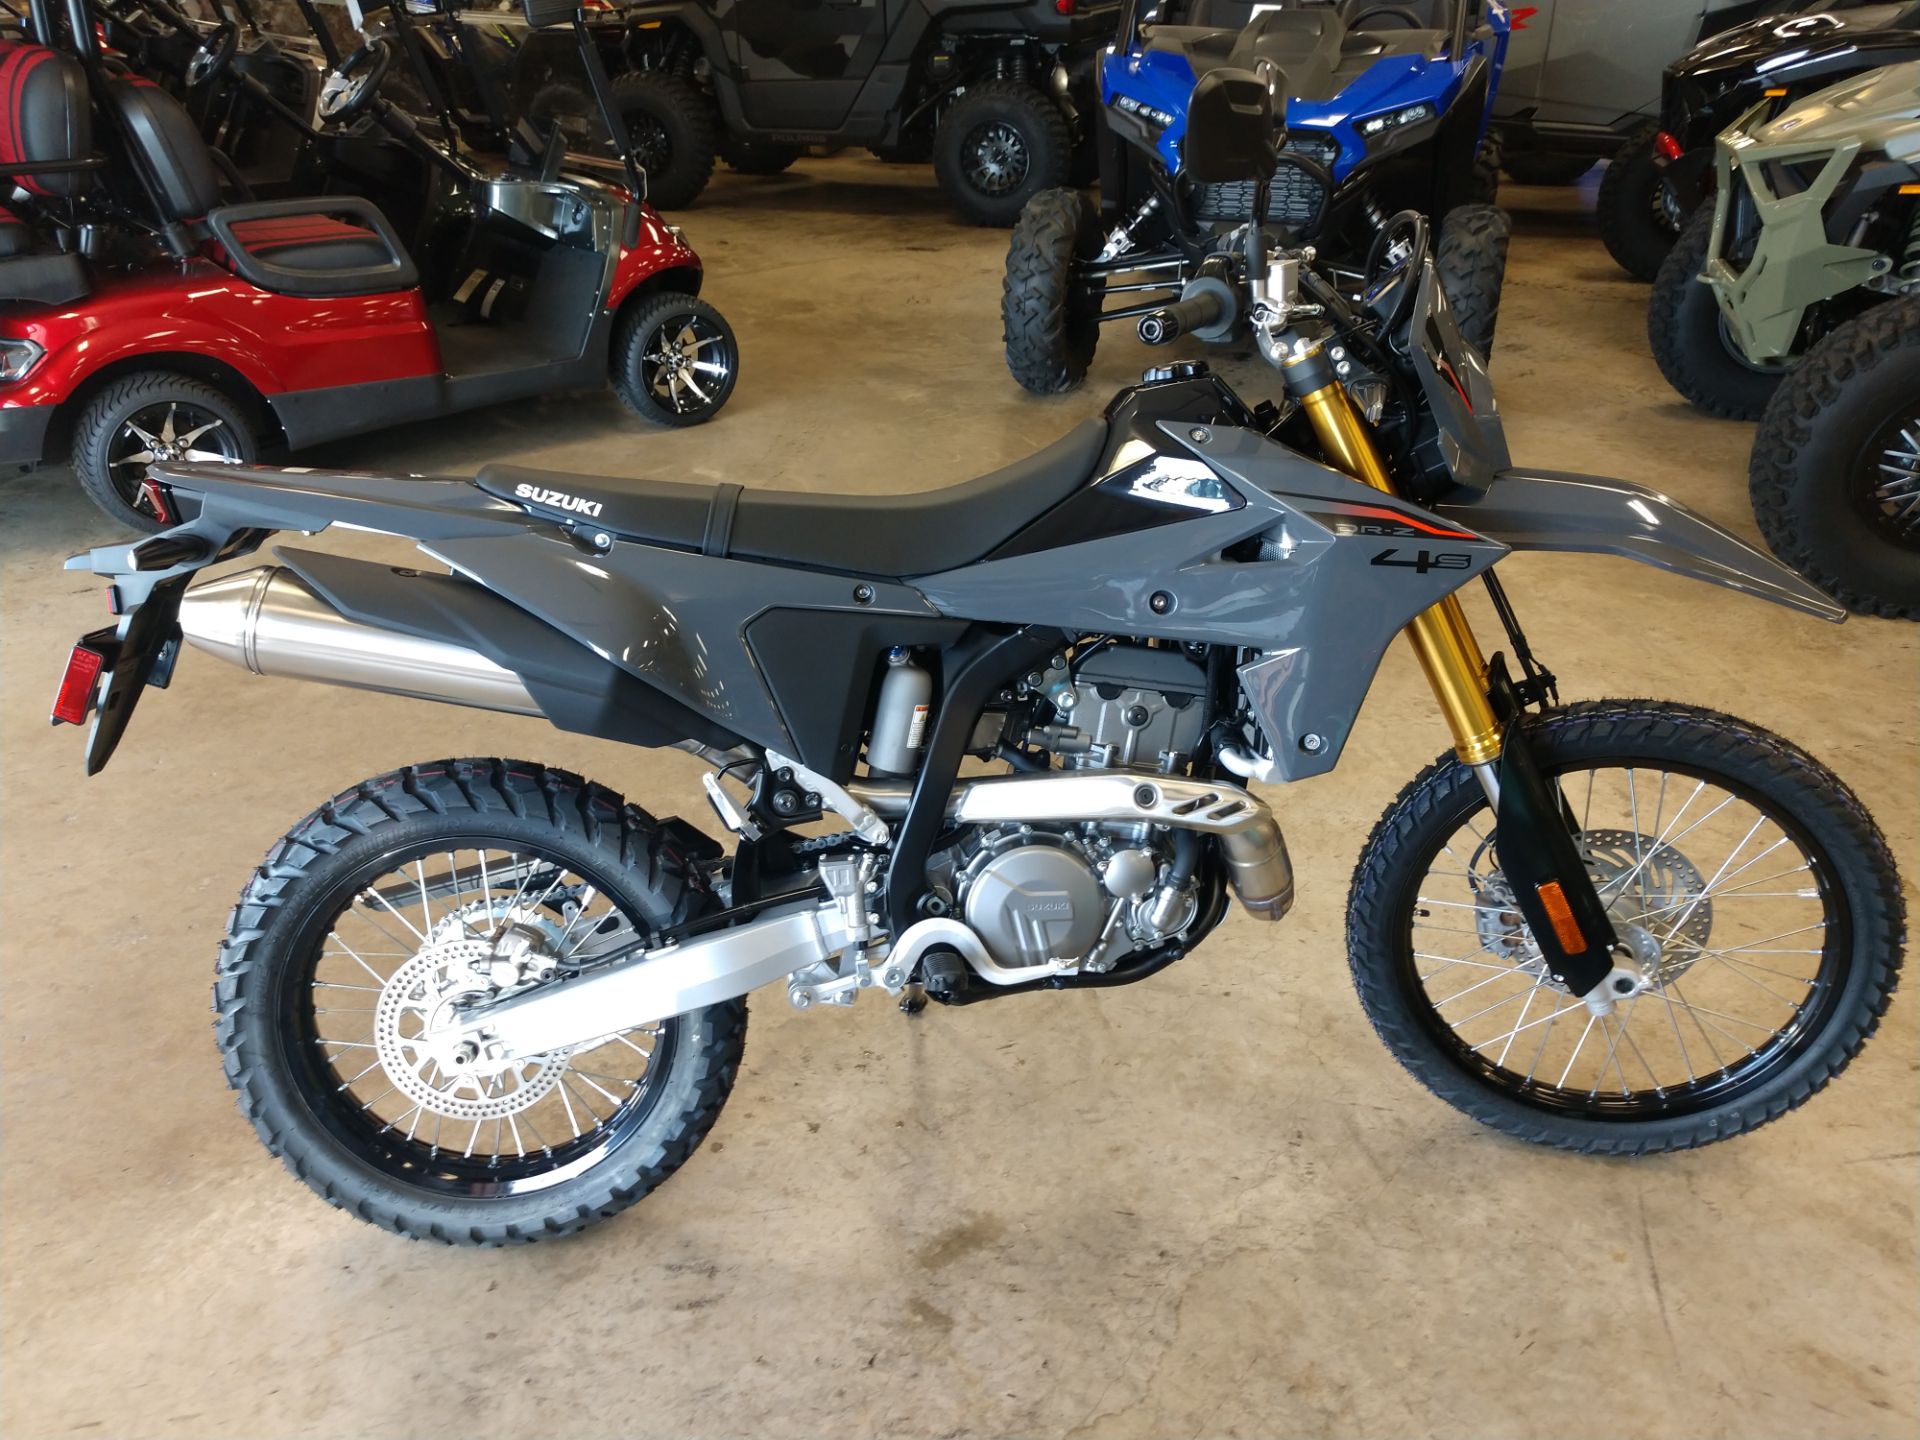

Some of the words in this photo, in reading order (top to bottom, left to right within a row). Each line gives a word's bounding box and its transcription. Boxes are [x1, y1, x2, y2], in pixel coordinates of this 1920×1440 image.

[515, 483, 603, 517] SUZUKI
[1335, 523, 1415, 536] DR-Z
[1370, 549, 1472, 574] 4S
